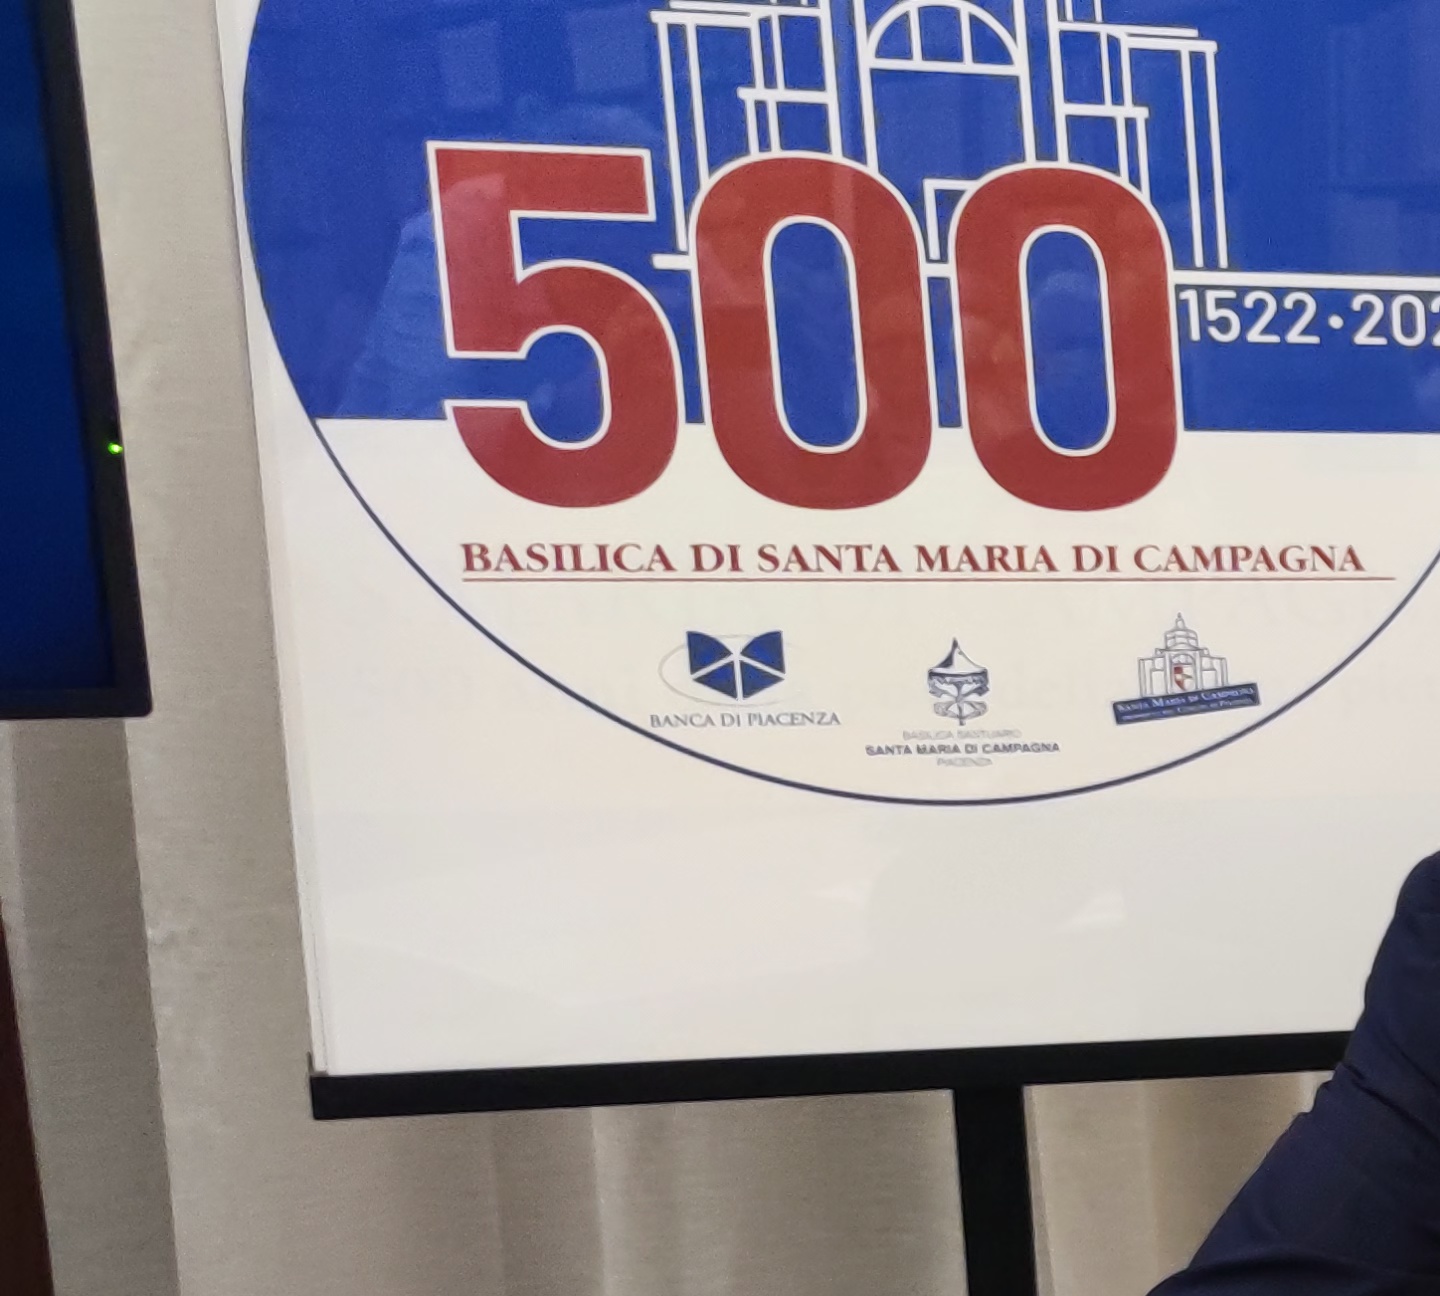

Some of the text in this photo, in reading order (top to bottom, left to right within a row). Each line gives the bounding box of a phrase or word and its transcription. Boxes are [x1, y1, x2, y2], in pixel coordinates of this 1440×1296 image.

[427, 140, 1178, 511] 500
[460, 543, 1366, 573] BASILICA DI SANTA MARIA DI CAMPAGNA
[650, 711, 842, 728] BANCA DI PIACENZA
[865, 742, 1060, 756] SANTA MARIA DI CAMPAGNA
